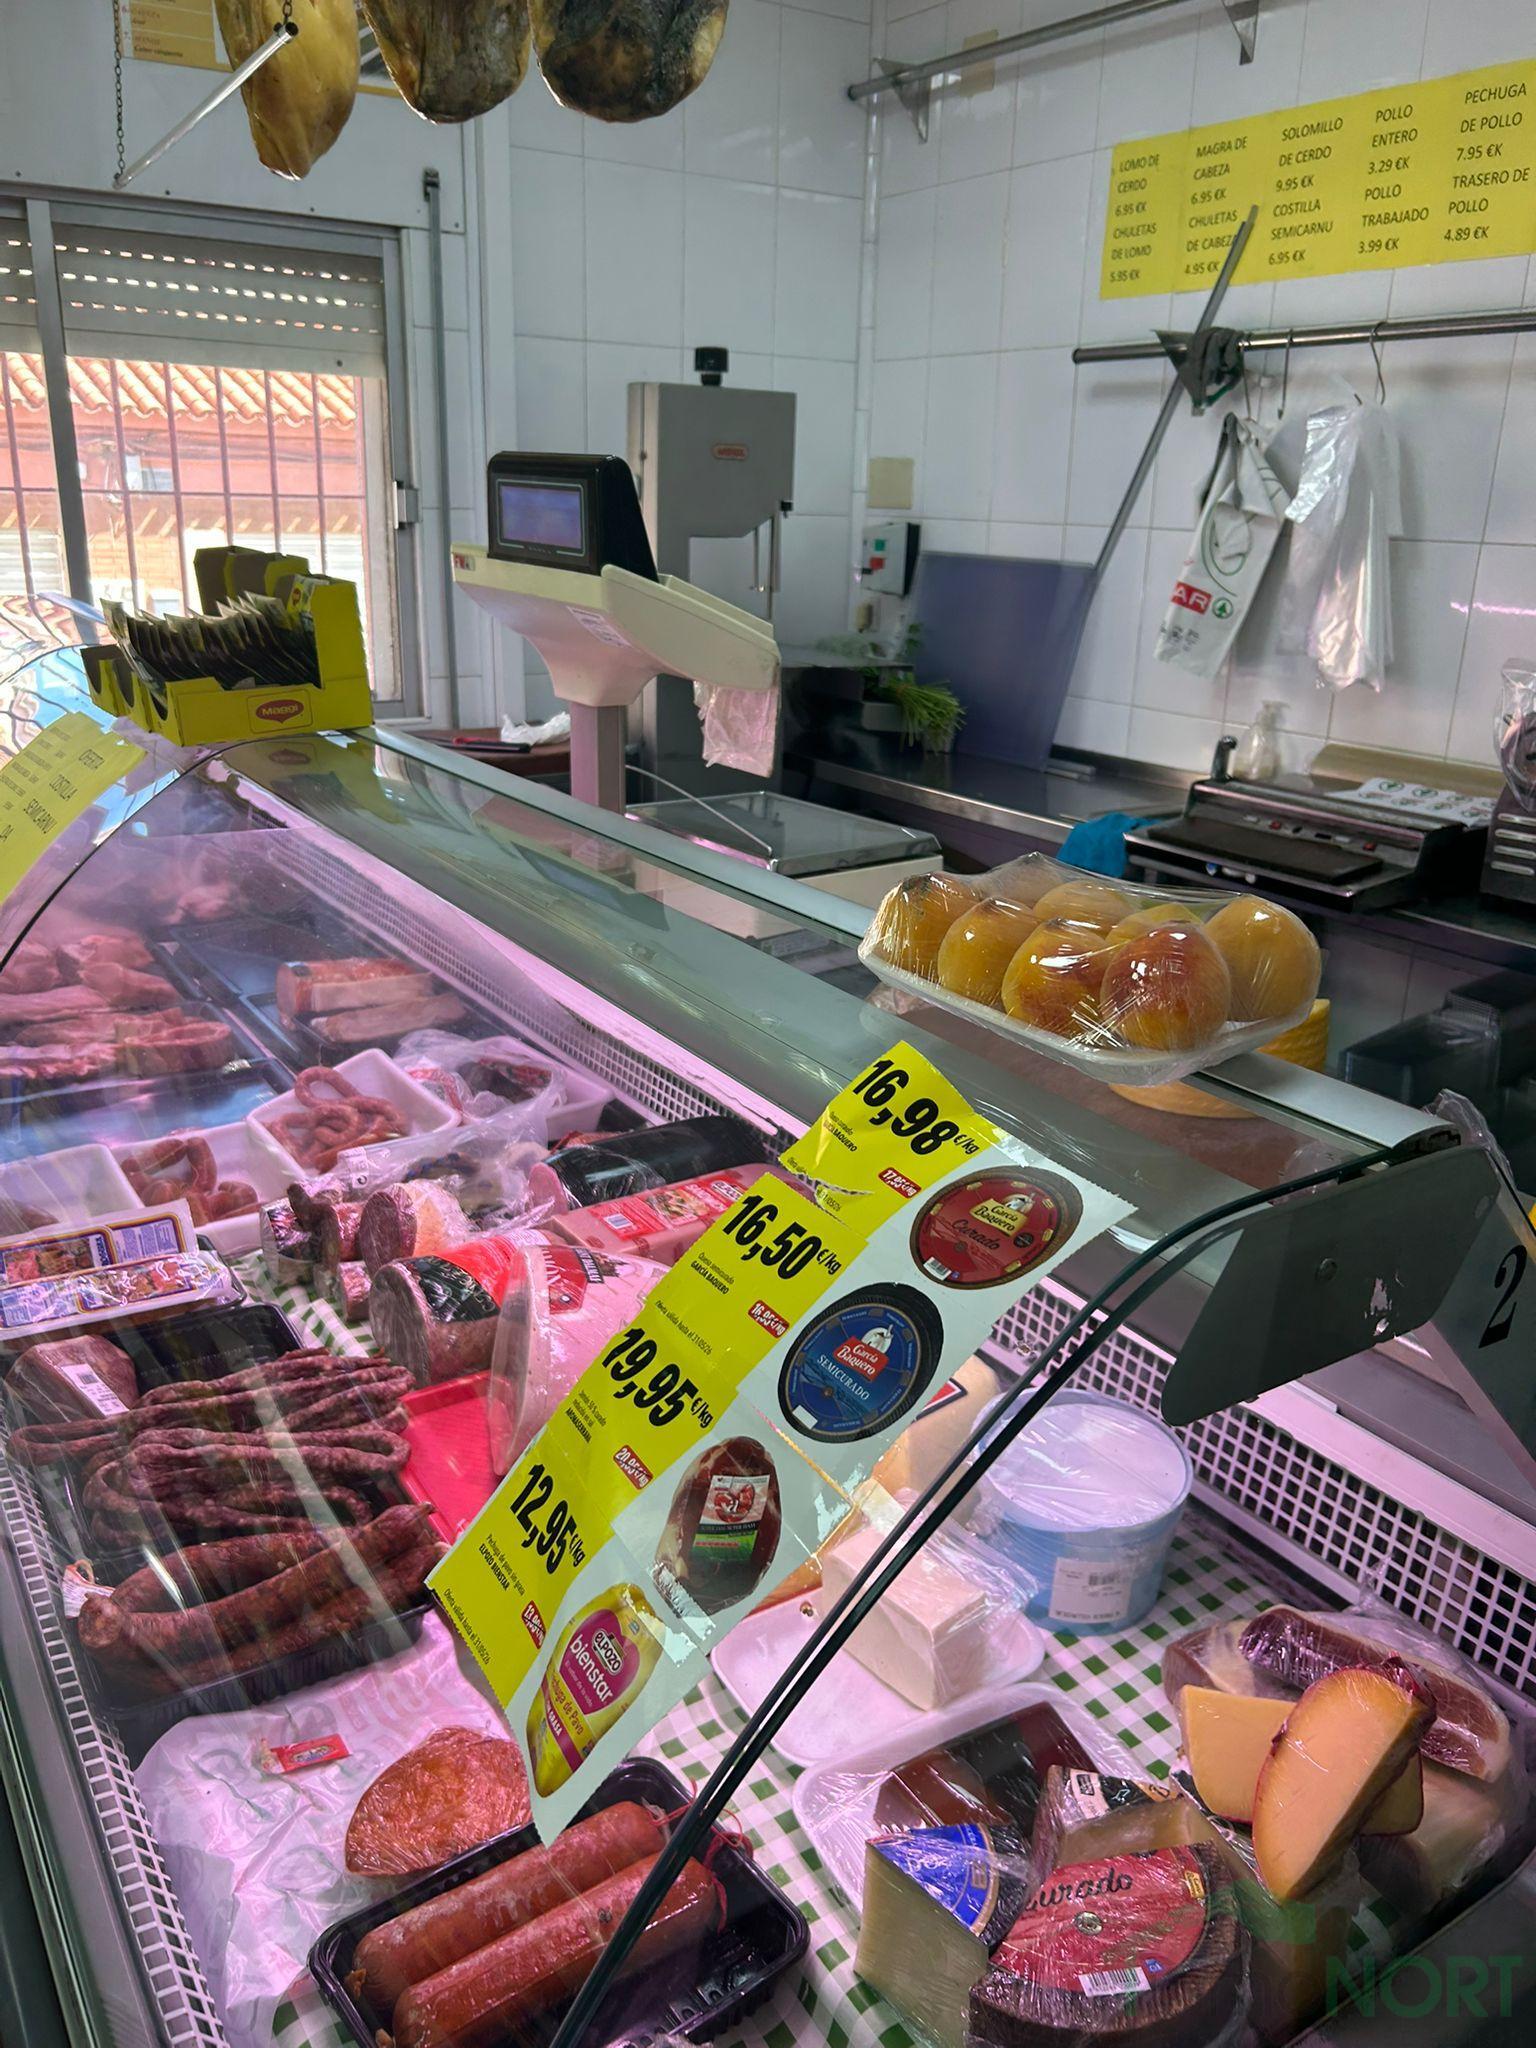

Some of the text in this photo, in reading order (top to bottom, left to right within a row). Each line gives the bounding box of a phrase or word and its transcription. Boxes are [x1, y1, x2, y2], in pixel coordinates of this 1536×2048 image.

[1464, 82, 1527, 105] PECHUGA
[1375, 104, 1413, 123] POLLO
[1460, 111, 1523, 134] DE POLLO
[1281, 117, 1344, 142] SOLOMILLO
[1372, 128, 1418, 148] ENTERO
[1196, 136, 1248, 158] MAGRA DE
[1279, 145, 1332, 167] DE CERDO
[1456, 143, 1503, 161] 7.95 €K
[1119, 154, 1160, 172] LOMO DE
[1193, 163, 1231, 181] CABEZA
[1368, 156, 1410, 175] 3.29 €K
[1117, 178, 1147, 194] CERDO
[1275, 178, 1298, 192] 9.95
[1453, 167, 1531, 189] TRASERO DE
[1190, 192, 1212, 205] 6.95
[1364, 184, 1402, 201] POLLO
[1273, 199, 1321, 218] COSTILLA
[1448, 197, 1489, 216] POLLO
[1188, 210, 1239, 229] CHULETAS
[1361, 206, 1430, 228] TRABAJADO
[1113, 223, 1157, 240] CHULETAS
[1271, 221, 1334, 241] SEMICARNU
[1443, 225, 1490, 242] 4.89 €K
[1111, 245, 1152, 260] DE LOMO
[1186, 235, 1235, 253] DE CABEZ
[1357, 239, 1382, 255] 3.99
[1268, 251, 1290, 265] 6.95
[853, 1060, 960, 1155] 16,98
[974, 1205, 1015, 1232] Baquero
[722, 1195, 822, 1280] 16,50
[952, 1219, 1000, 1250] Curado
[1478, 1245, 1528, 1349] 2
[837, 1345, 876, 1376] Baquero
[602, 1328, 699, 1427] 19,95
[817, 1354, 871, 1401] SEMICURADO
[510, 1464, 577, 1574] 12,95
[569, 1634, 613, 1702] bienstar
[563, 1699, 572, 1713] de
[568, 1711, 584, 1735] Pavo
